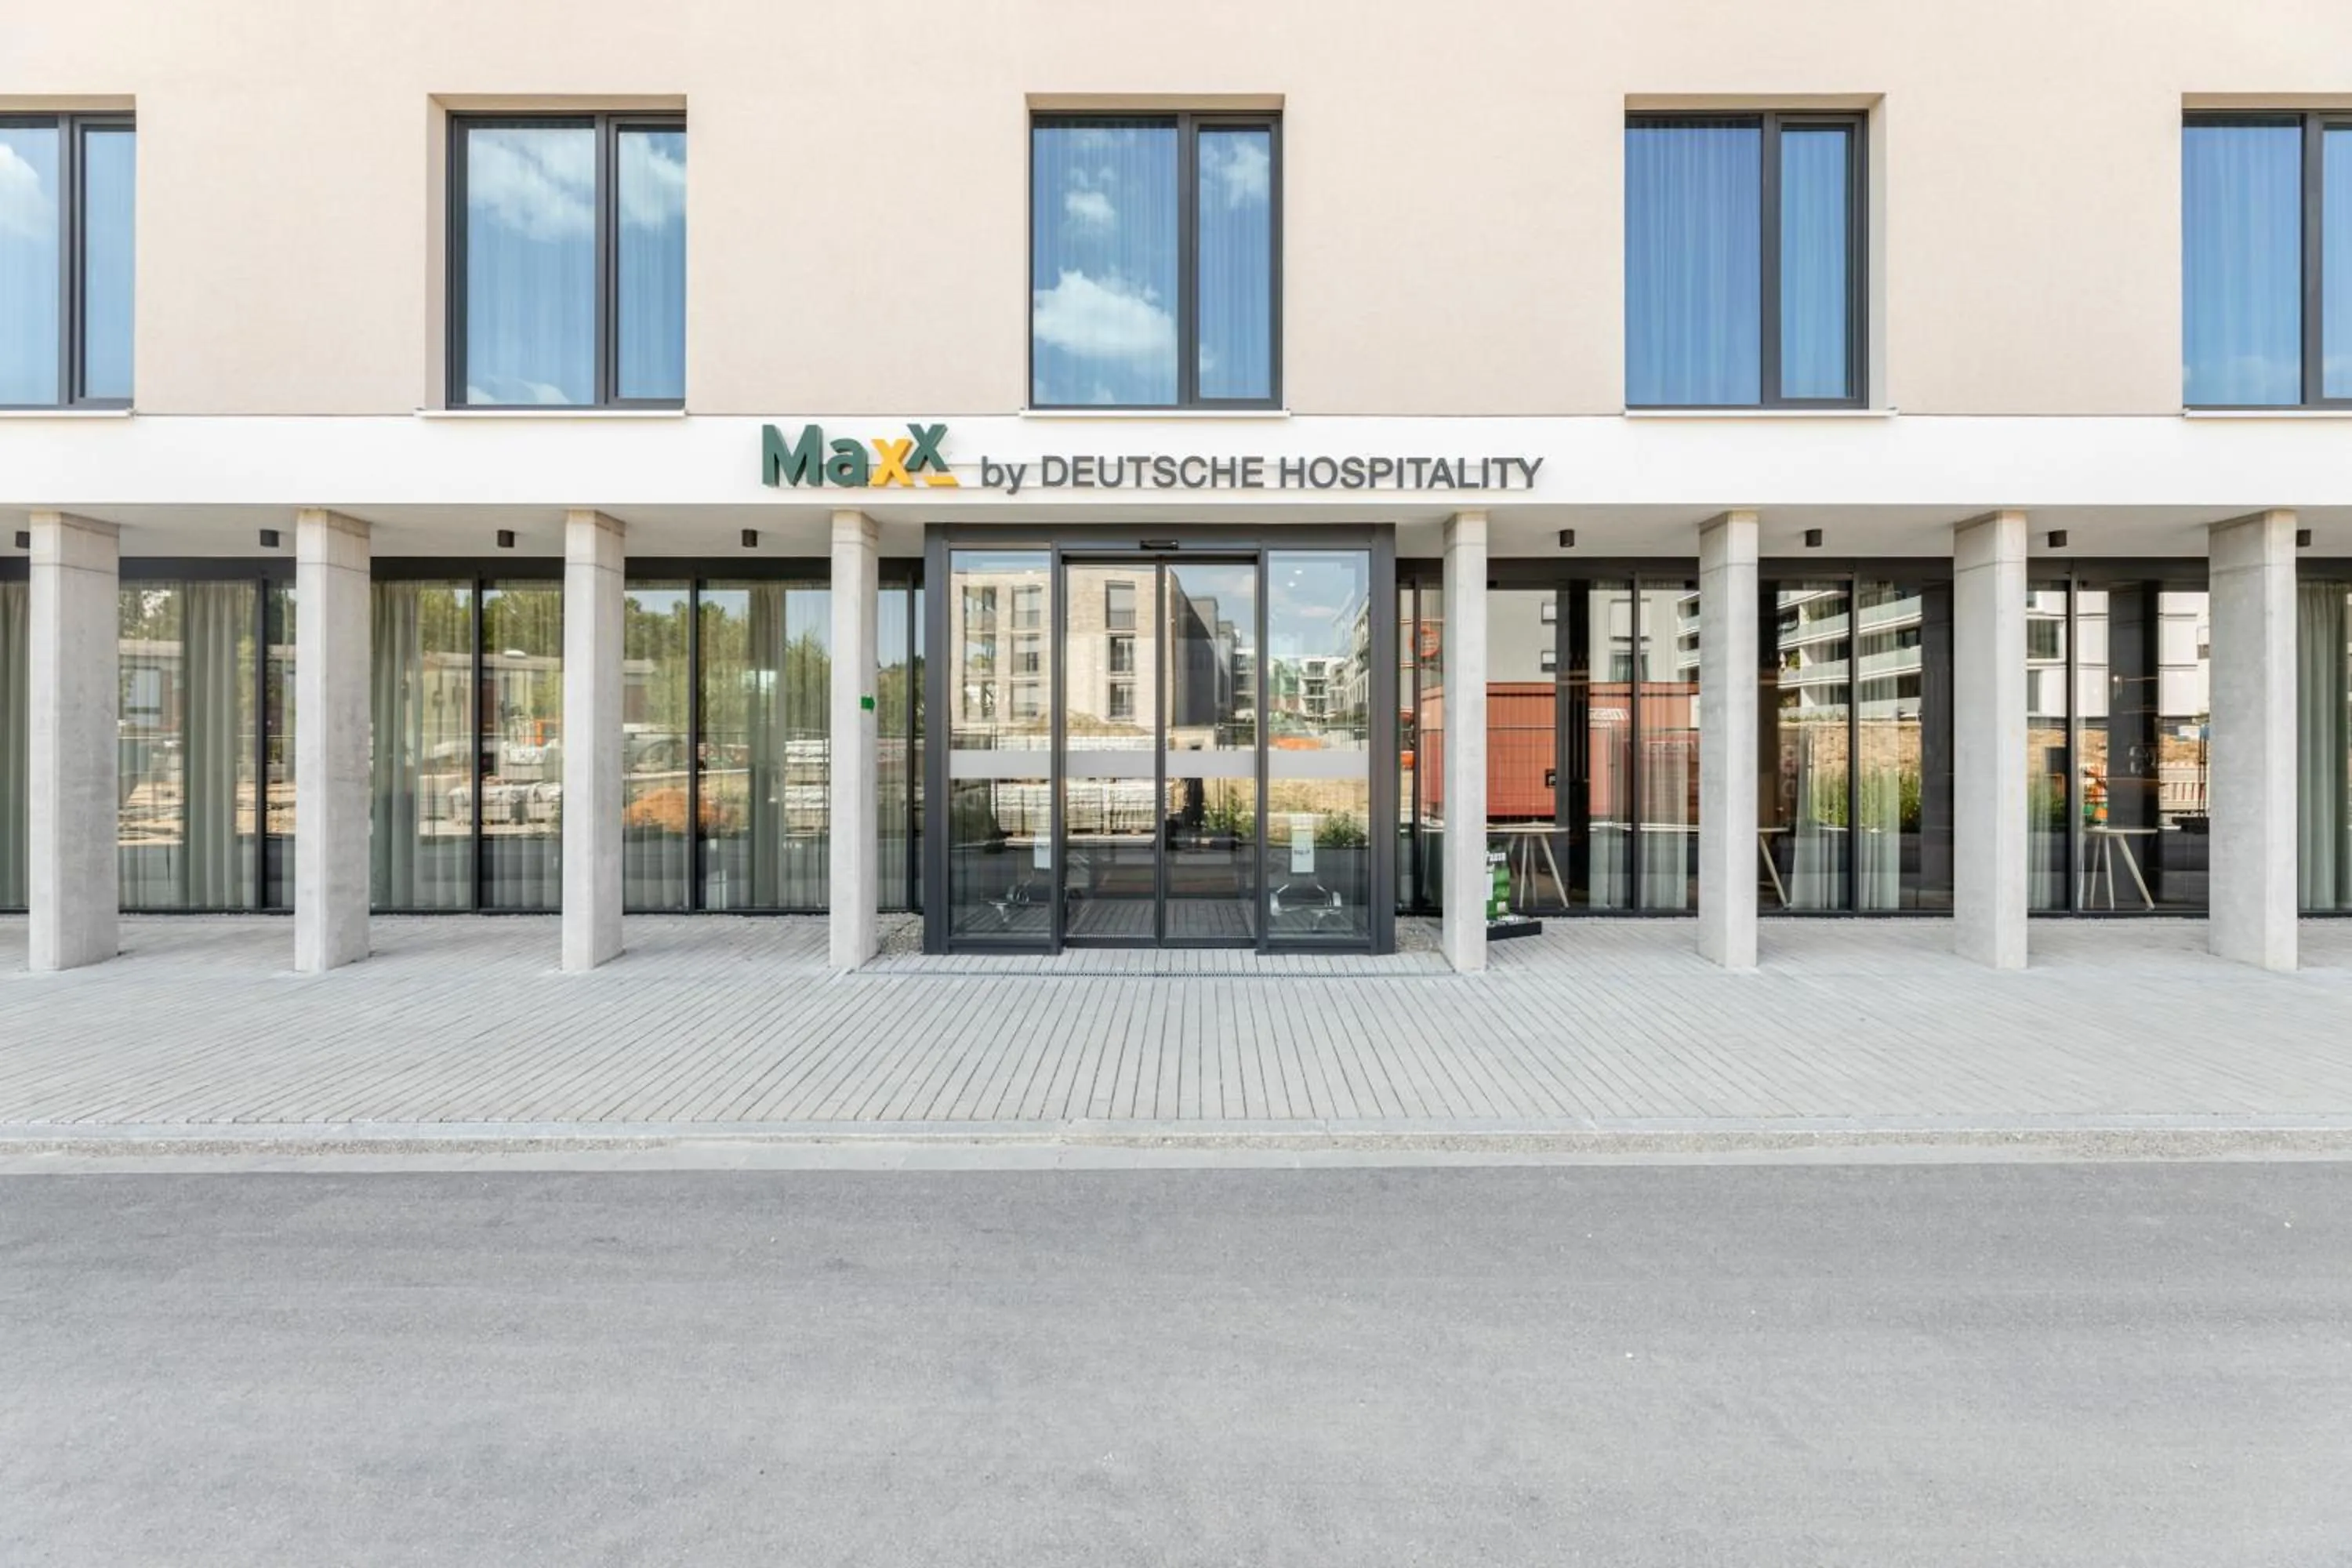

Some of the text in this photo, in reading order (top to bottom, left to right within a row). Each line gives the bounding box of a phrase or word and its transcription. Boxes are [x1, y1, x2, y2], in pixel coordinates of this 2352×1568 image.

[981, 456, 1027, 495] by
[1042, 456, 1264, 488] DEUTSCHE
[1279, 456, 1544, 488] HOSPITALITY
